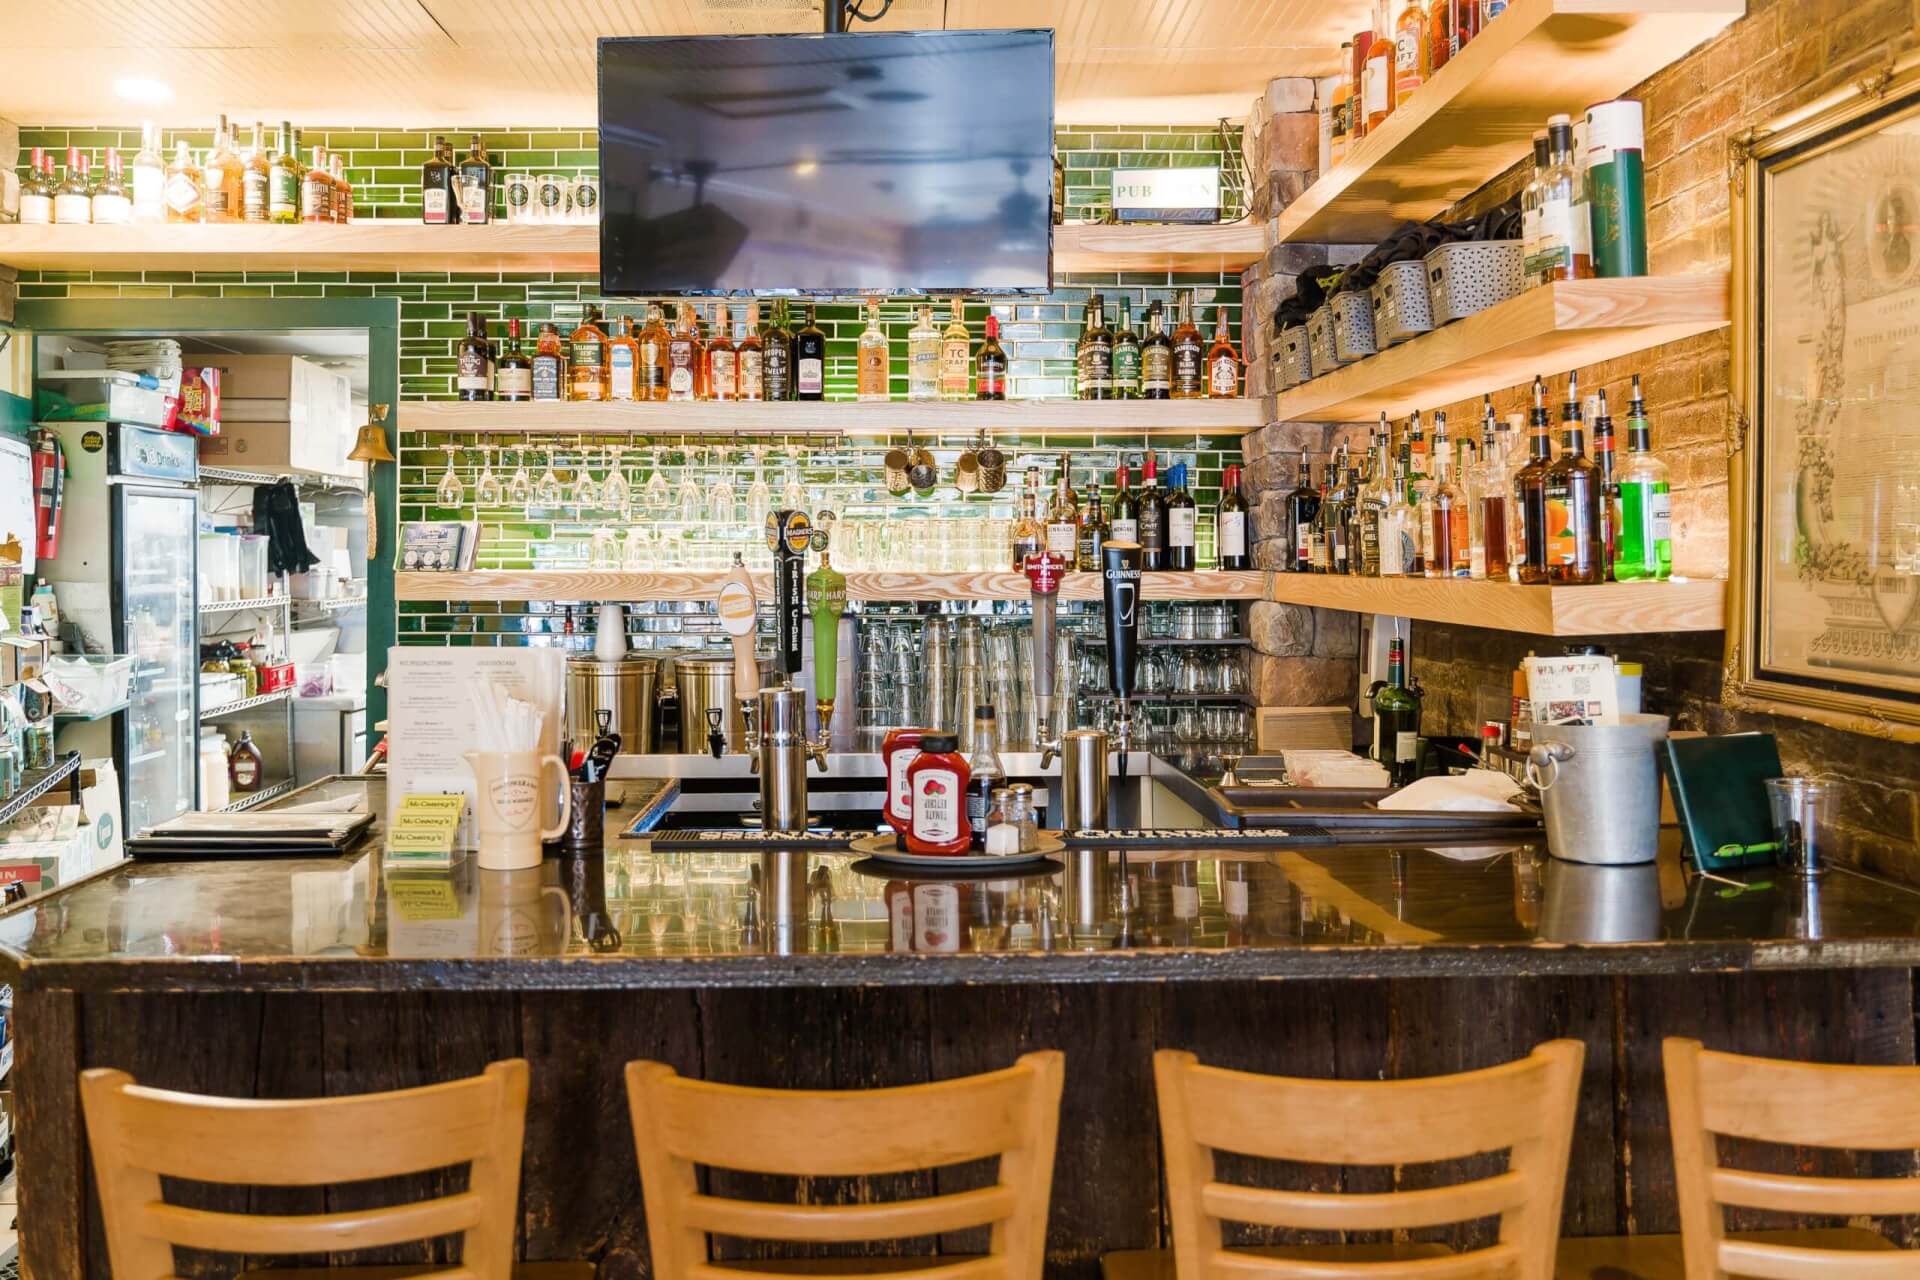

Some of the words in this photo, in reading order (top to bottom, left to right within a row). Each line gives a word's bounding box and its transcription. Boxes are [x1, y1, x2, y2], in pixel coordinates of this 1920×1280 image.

[1116, 184, 1152, 199] PUB
[764, 348, 787, 358] PROPER
[950, 348, 963, 359] TC
[1085, 345, 1111, 354] JAMESON
[1174, 344, 1201, 353] JAMESON
[764, 366, 787, 376] TWELVE
[1105, 569, 1141, 581] GUINNESS
[791, 561, 799, 605] IRISH
[826, 590, 847, 601] HARP
[791, 609, 799, 652] CIDER
